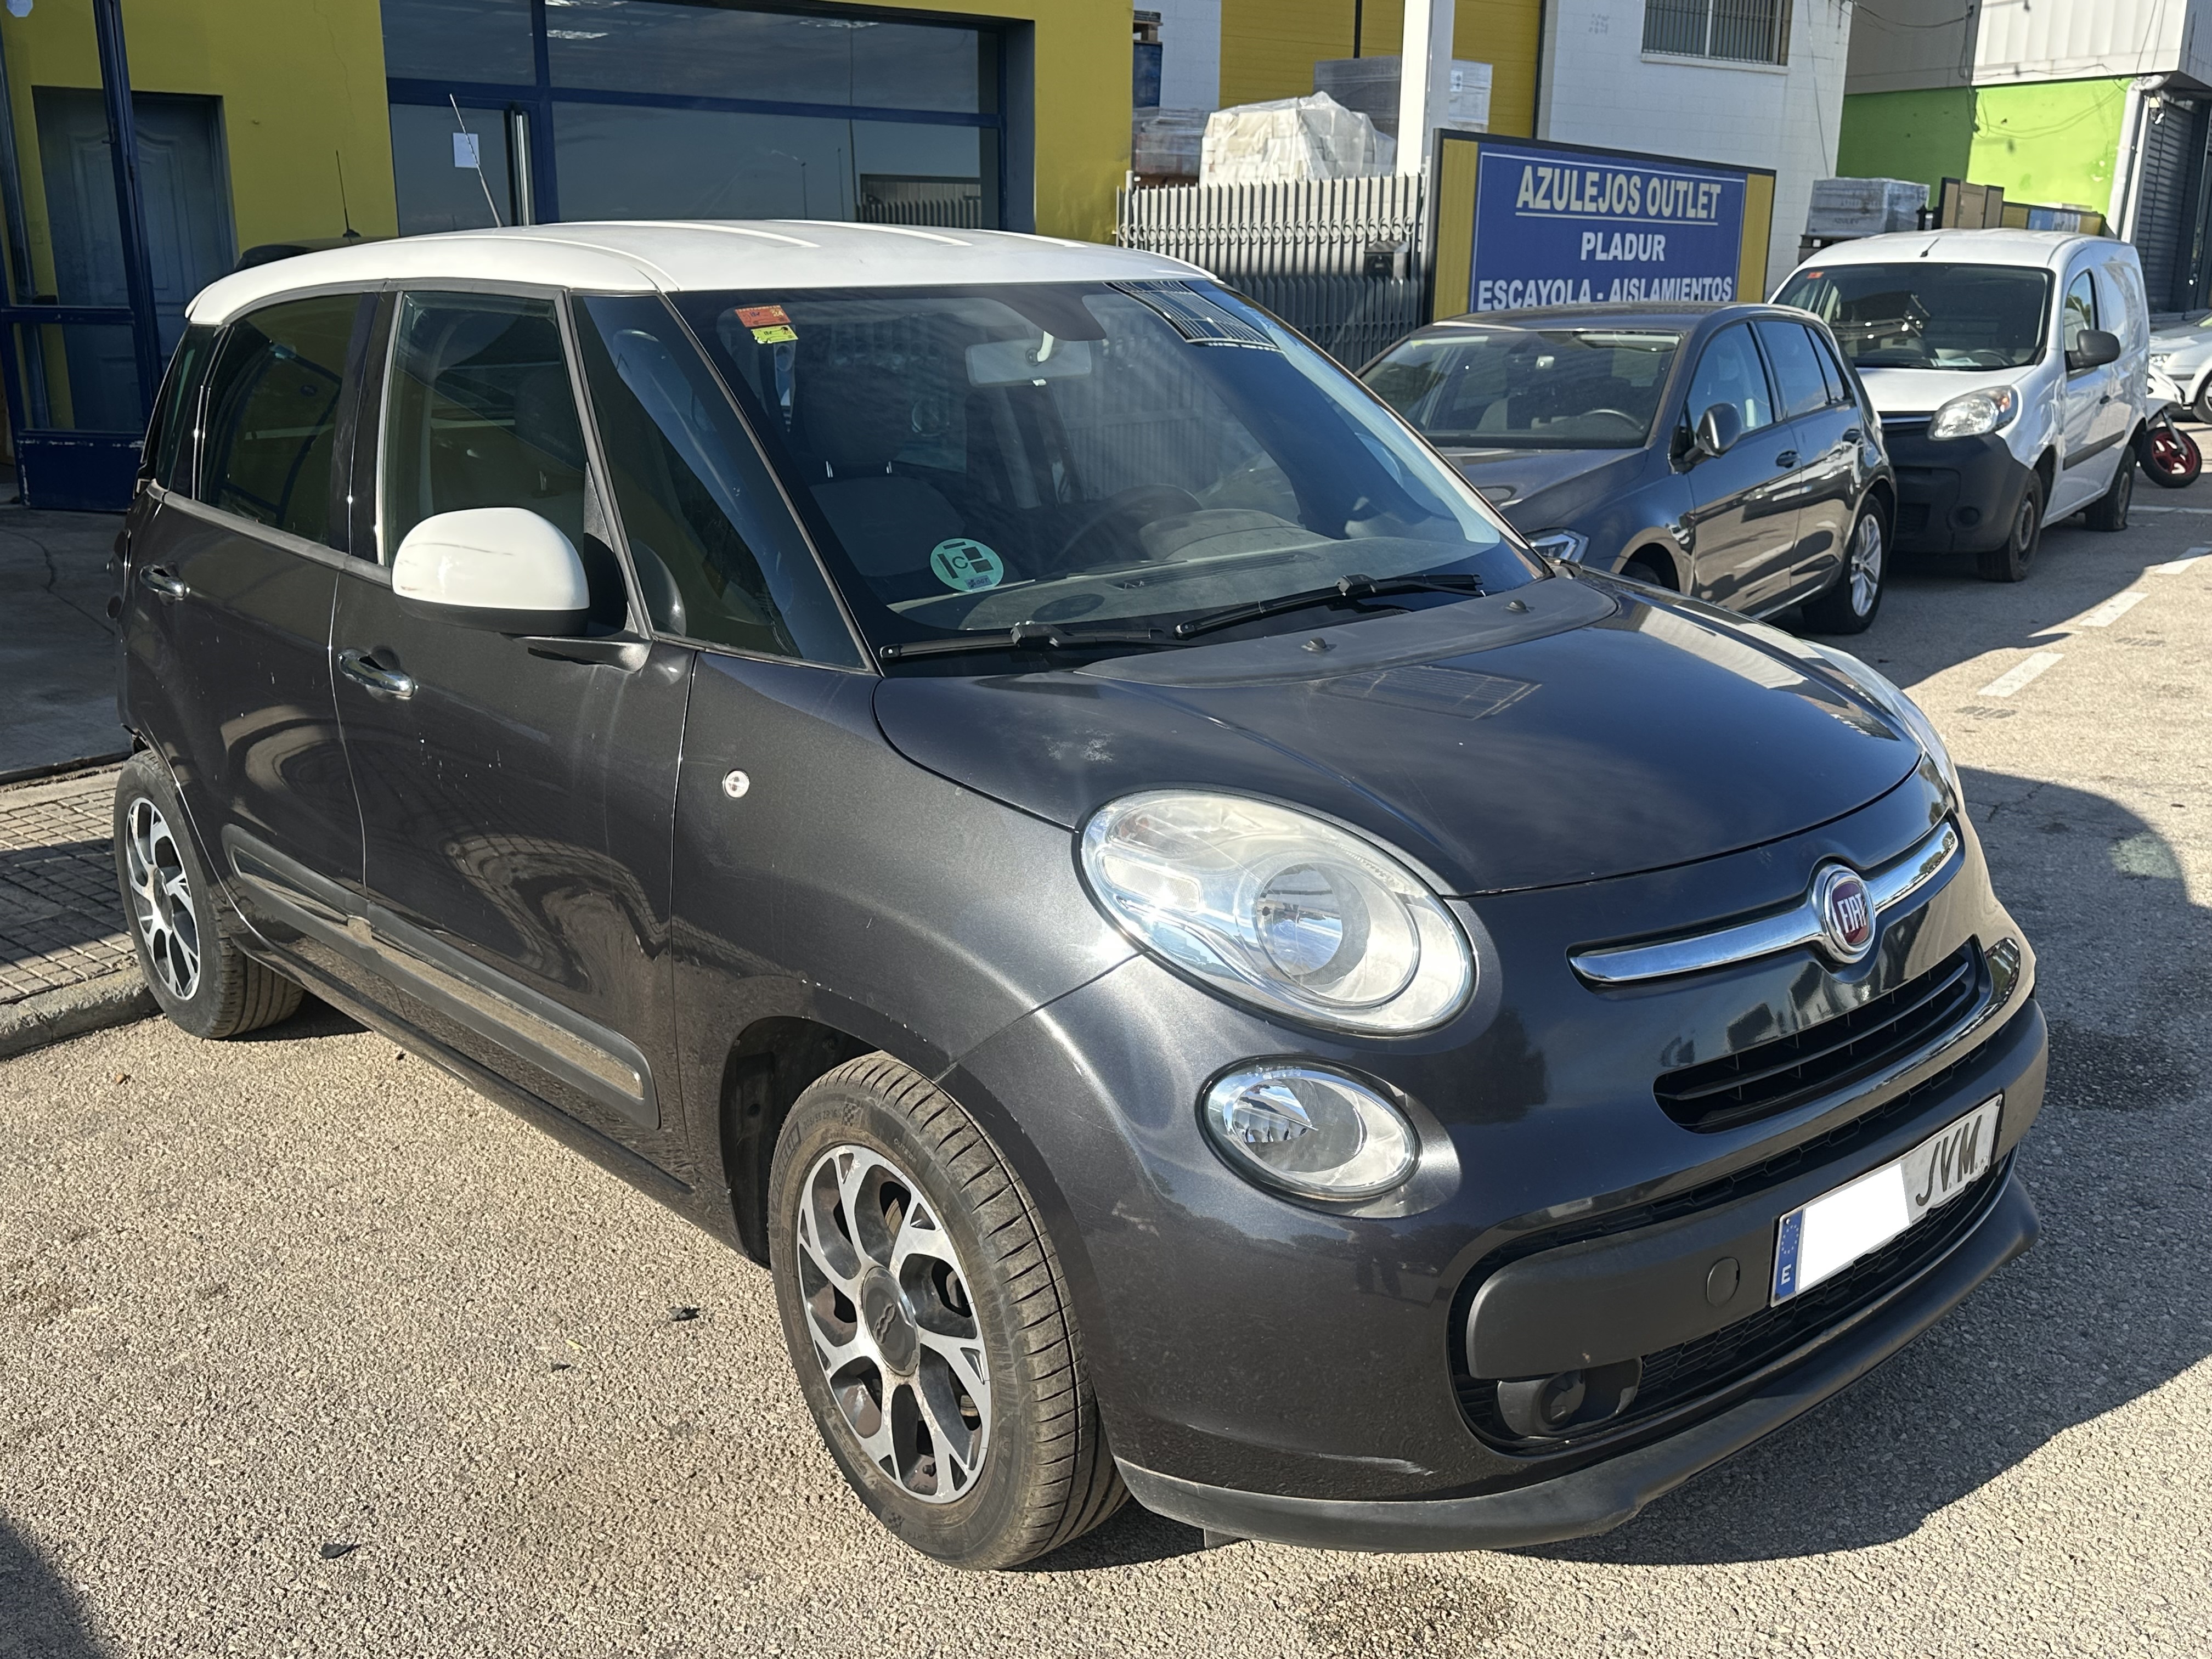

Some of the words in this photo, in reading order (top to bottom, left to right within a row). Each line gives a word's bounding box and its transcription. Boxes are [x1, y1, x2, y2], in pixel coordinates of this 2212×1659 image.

[1516, 165, 1641, 215] AZULEJOS
[1646, 177, 1722, 219] OUTLET
[1580, 232, 1666, 262] PLADUR
[1477, 279, 1591, 311] ESCAYOLA
[1609, 276, 1733, 302] AISLAMIENTOS
[952, 556, 968, 569] C
[1837, 893, 1866, 934] FIAT
[1915, 1114, 1983, 1207] JVM
[1780, 1263, 1792, 1285] E
